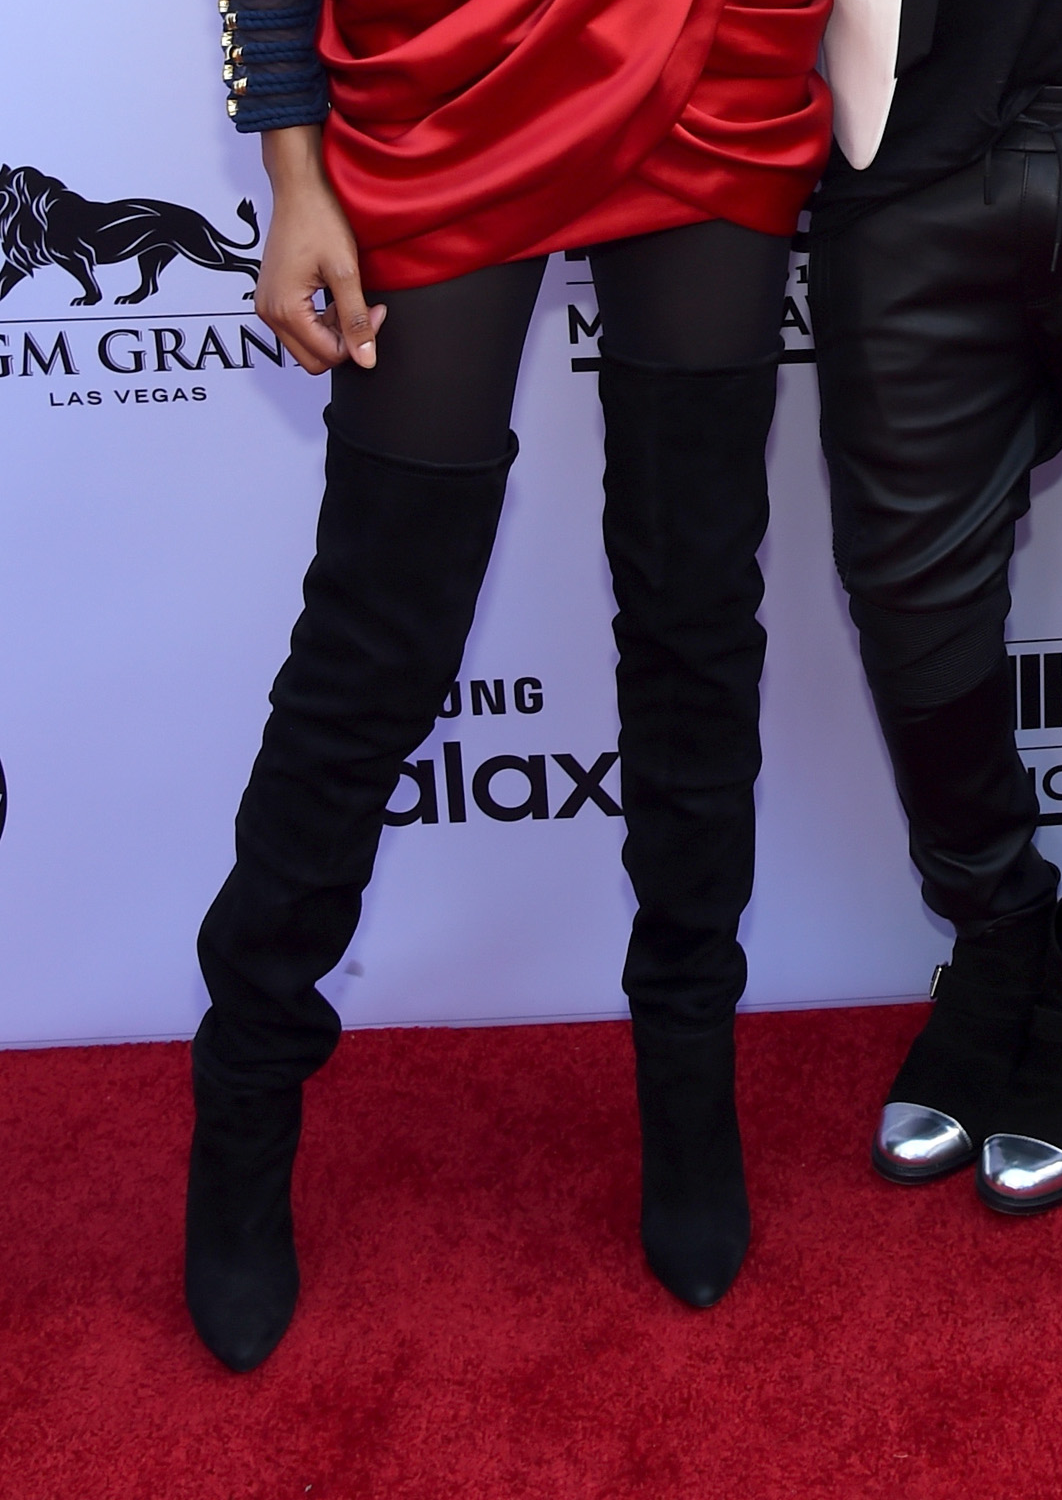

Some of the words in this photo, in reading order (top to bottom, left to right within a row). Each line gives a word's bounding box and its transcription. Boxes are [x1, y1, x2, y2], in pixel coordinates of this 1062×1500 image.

[97, 324, 302, 374] GRAN
[49, 390, 103, 407] LAS
[114, 386, 208, 405] VEGAS
[382, 741, 625, 827] alax
